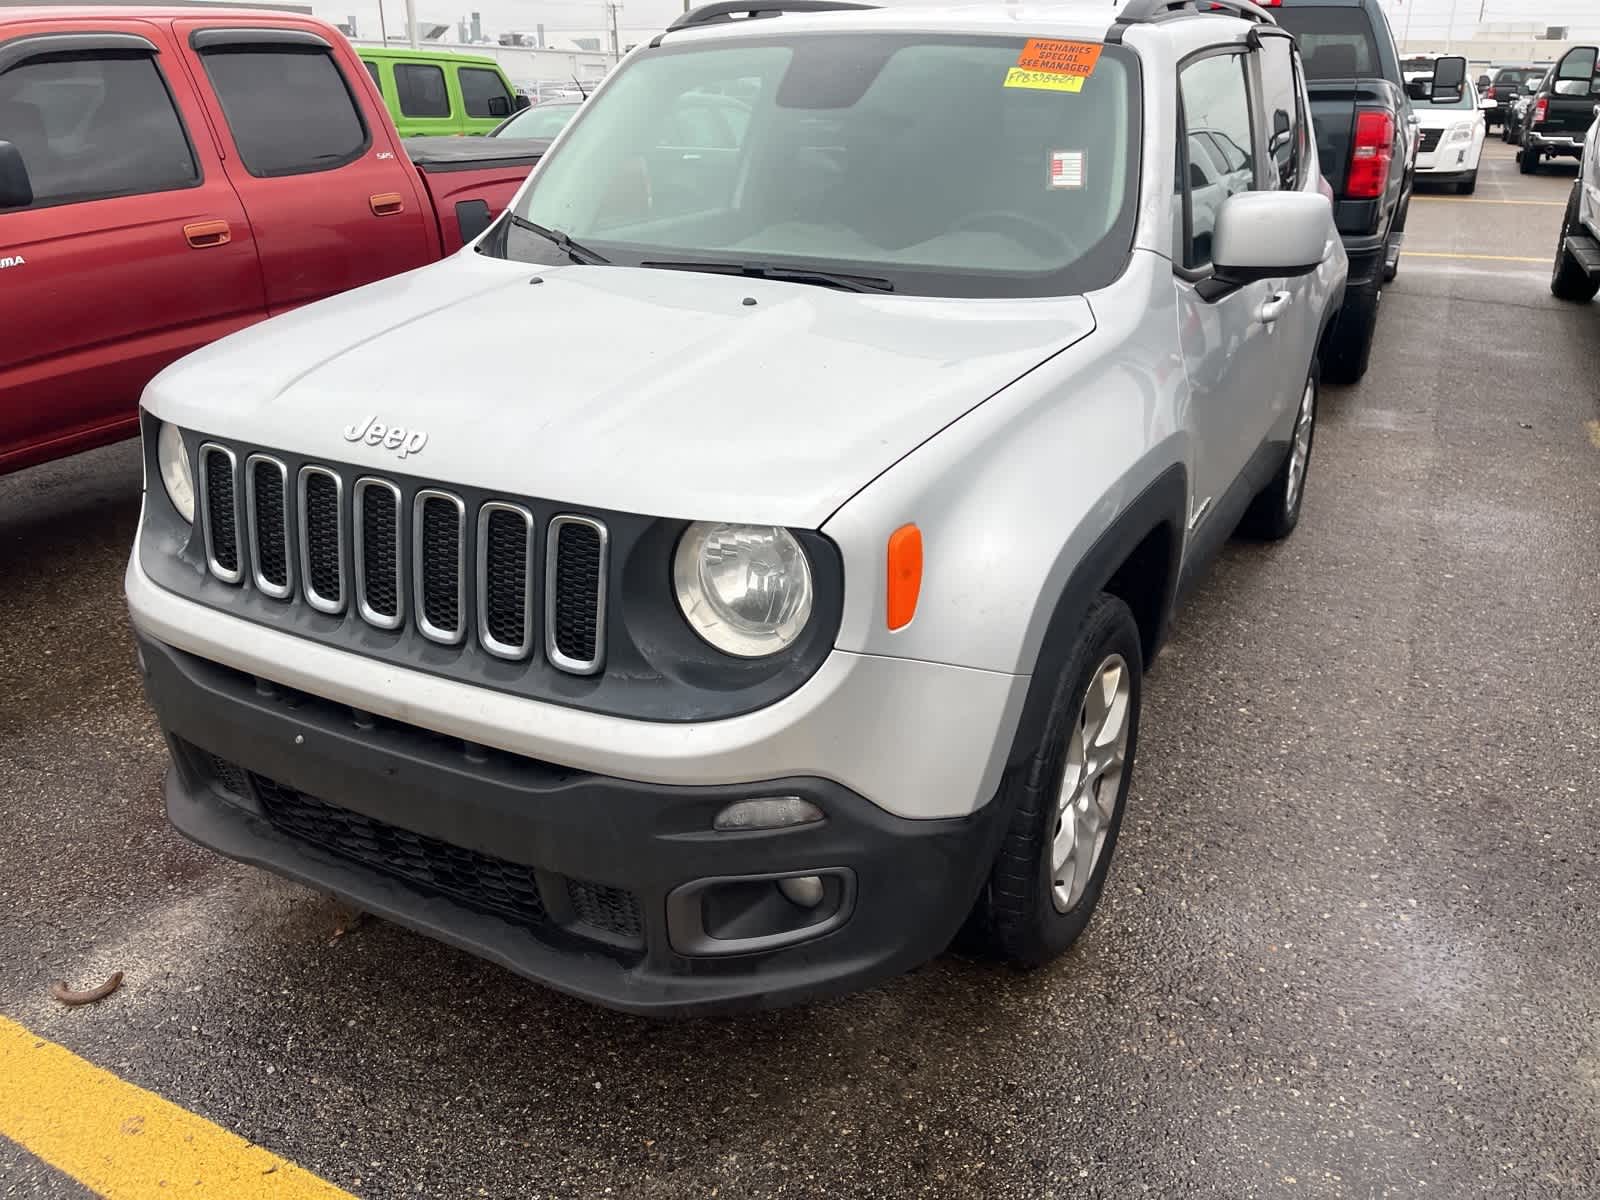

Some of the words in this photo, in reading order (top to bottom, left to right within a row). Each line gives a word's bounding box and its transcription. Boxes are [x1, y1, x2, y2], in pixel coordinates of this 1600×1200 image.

[1034, 42, 1092, 54] MECHANICS
[1038, 51, 1079, 62] SPECIAL
[1020, 58, 1040, 67] SEE
[1040, 60, 1089, 73] MANAGER
[343, 415, 429, 460] Jeep
